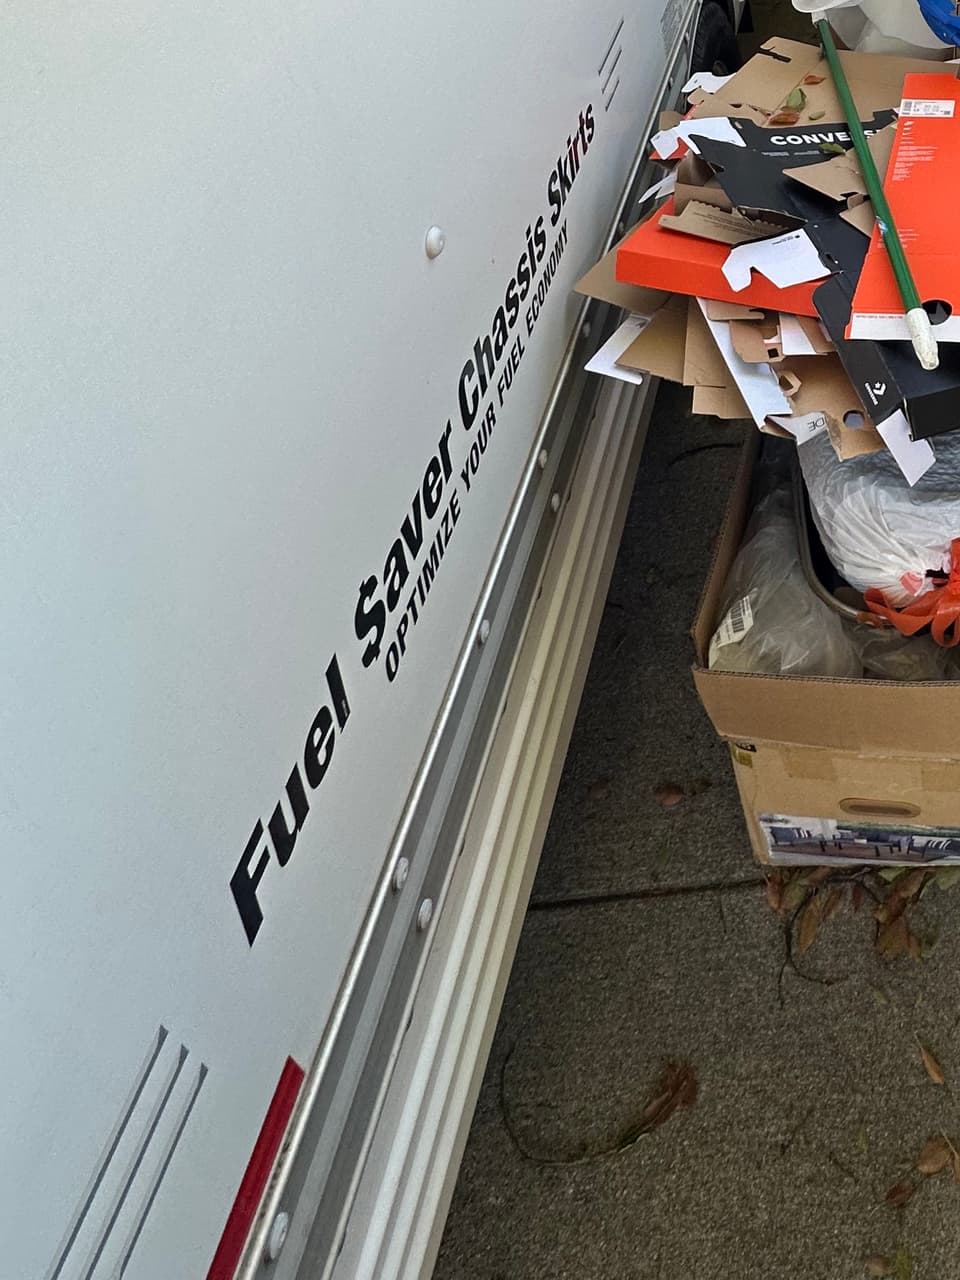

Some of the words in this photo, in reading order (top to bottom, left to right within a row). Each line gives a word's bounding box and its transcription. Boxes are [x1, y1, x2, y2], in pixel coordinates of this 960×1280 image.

[770, 129, 881, 146] CONVES
[229, 653, 350, 947] Fuel
[457, 213, 548, 428] Chassis
[547, 102, 597, 227] Skirts
[383, 488, 462, 684] OPTIMIZE
[461, 400, 499, 499] YOUR
[497, 333, 528, 408] FUEL
[525, 217, 571, 340] ECONOMY
